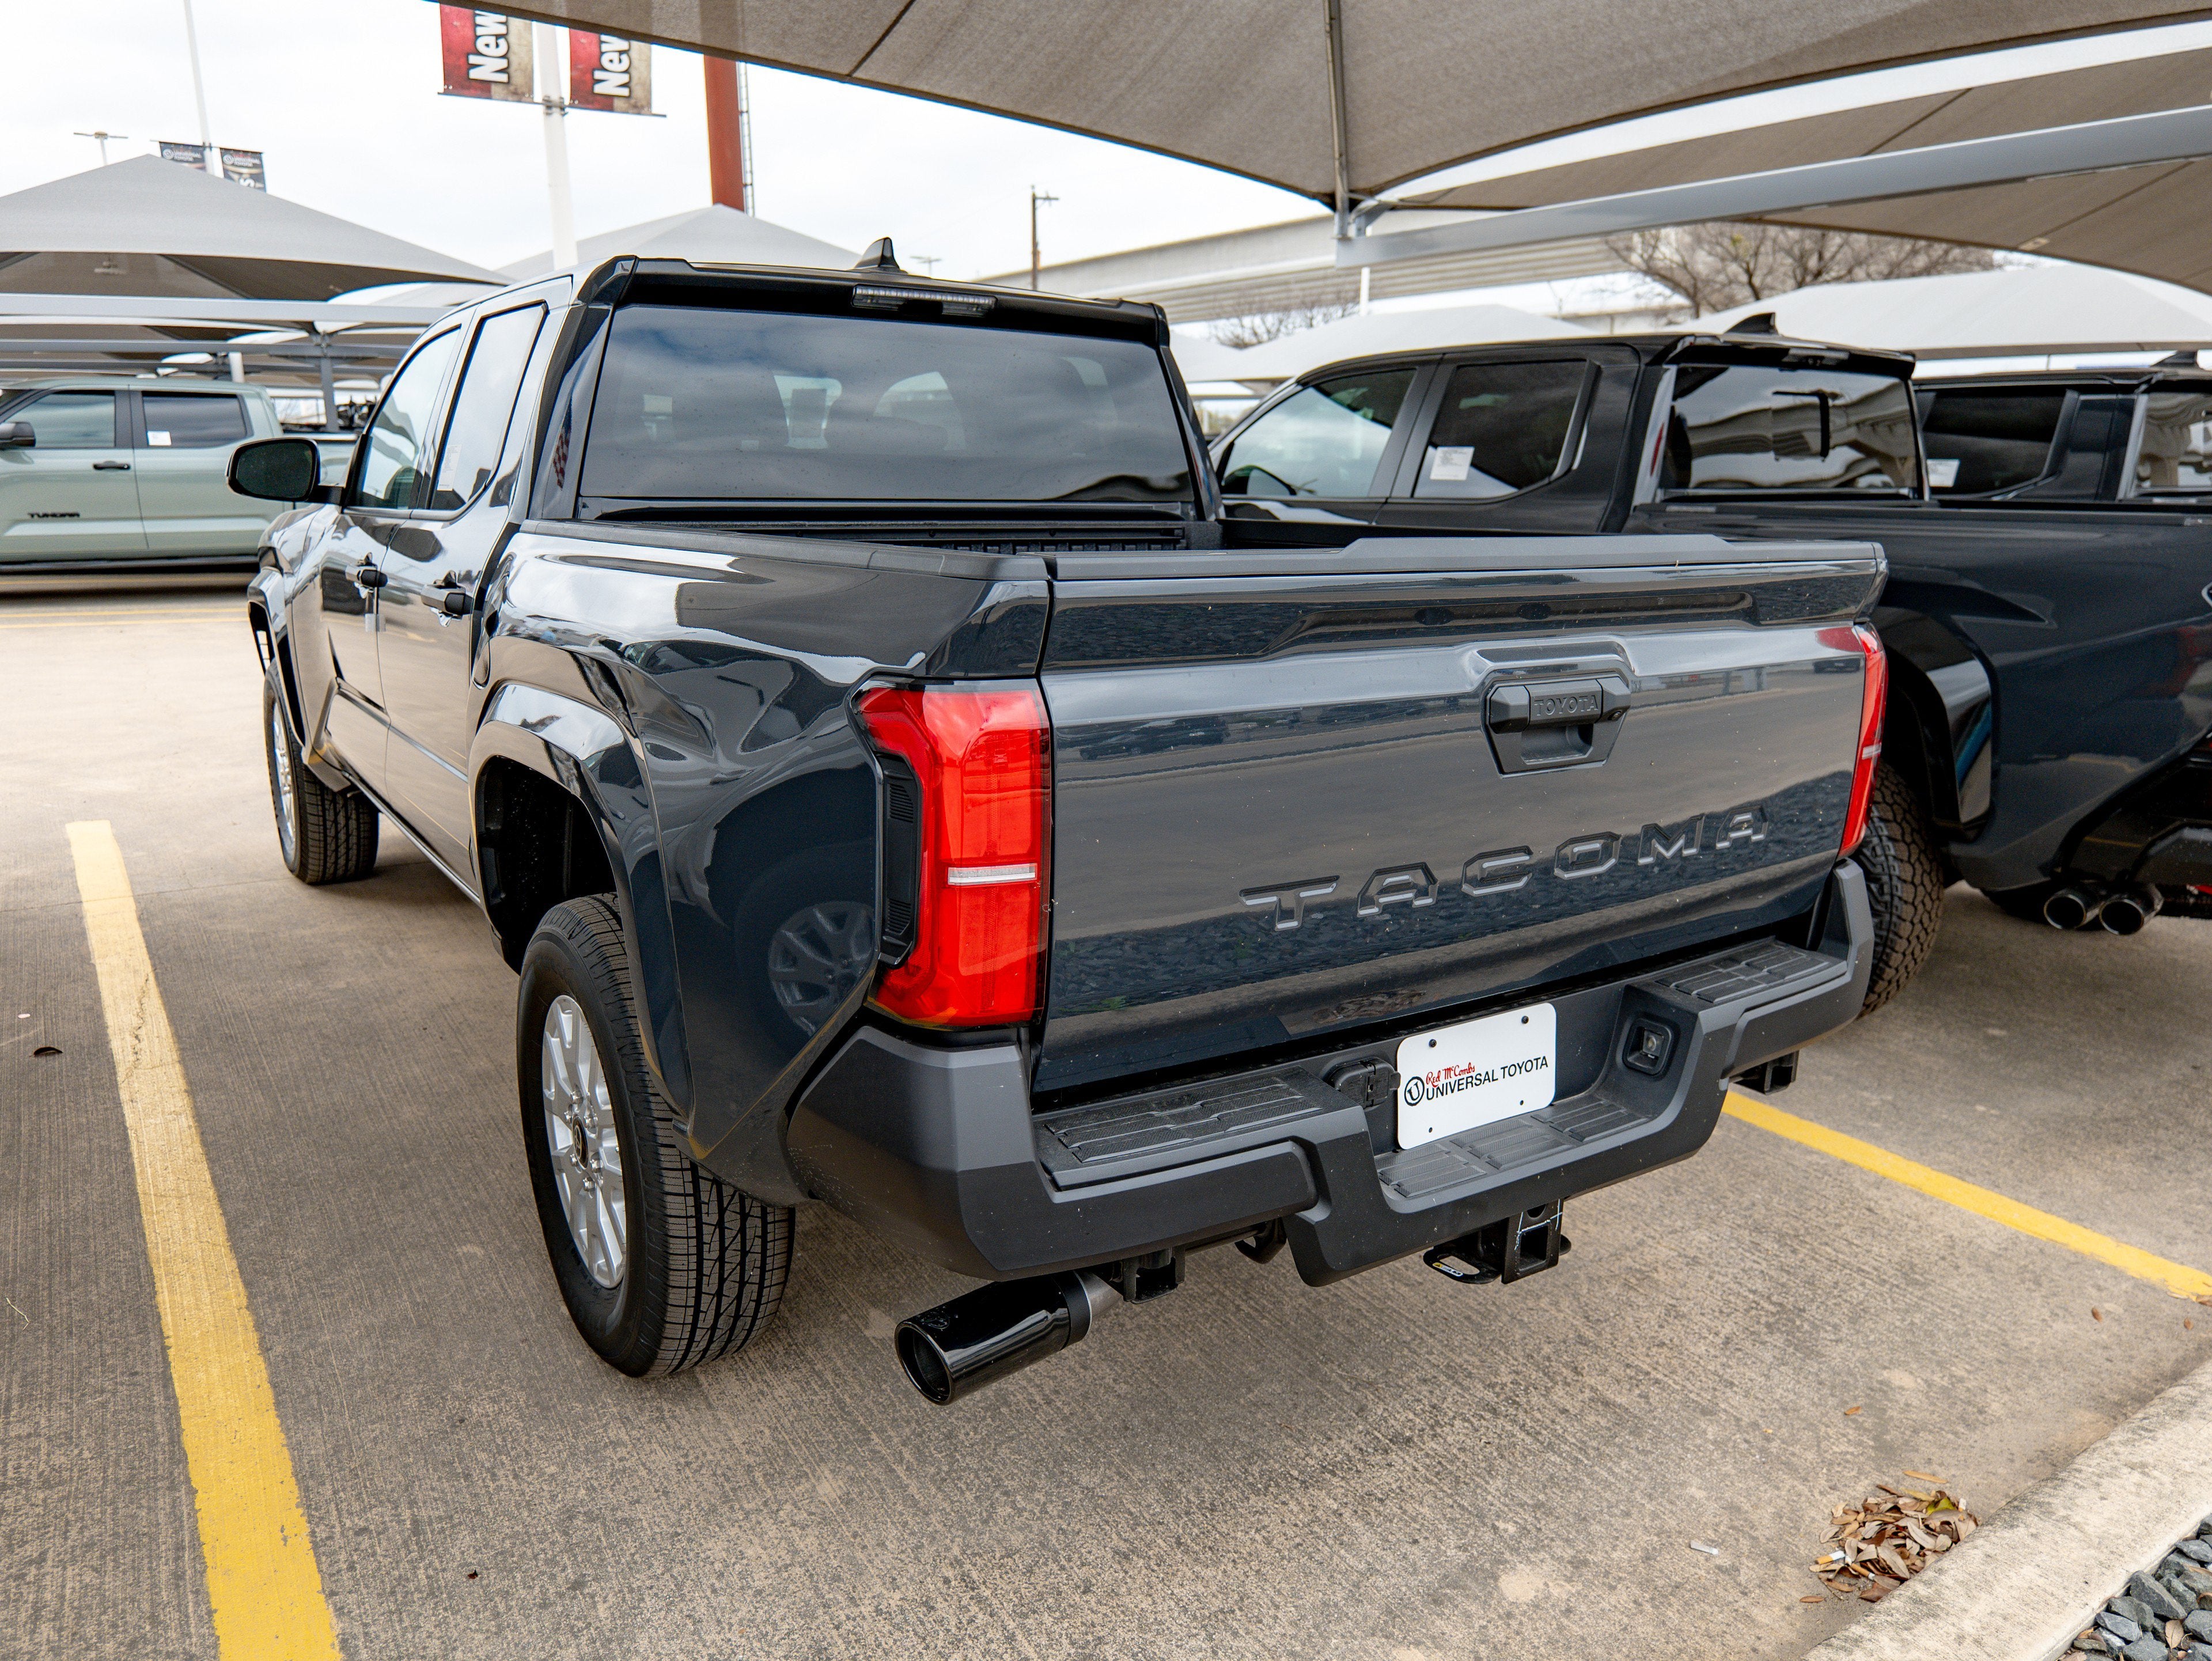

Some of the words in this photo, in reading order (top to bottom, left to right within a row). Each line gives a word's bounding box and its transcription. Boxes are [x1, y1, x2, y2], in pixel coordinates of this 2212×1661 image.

[468, 10, 509, 82] New
[1533, 695, 1599, 716] TOYOTA
[1239, 806, 1770, 932] TACOMA
[1426, 1069, 1498, 1101] UNIVERSAL
[1501, 1055, 1548, 1080] TOYOTA
